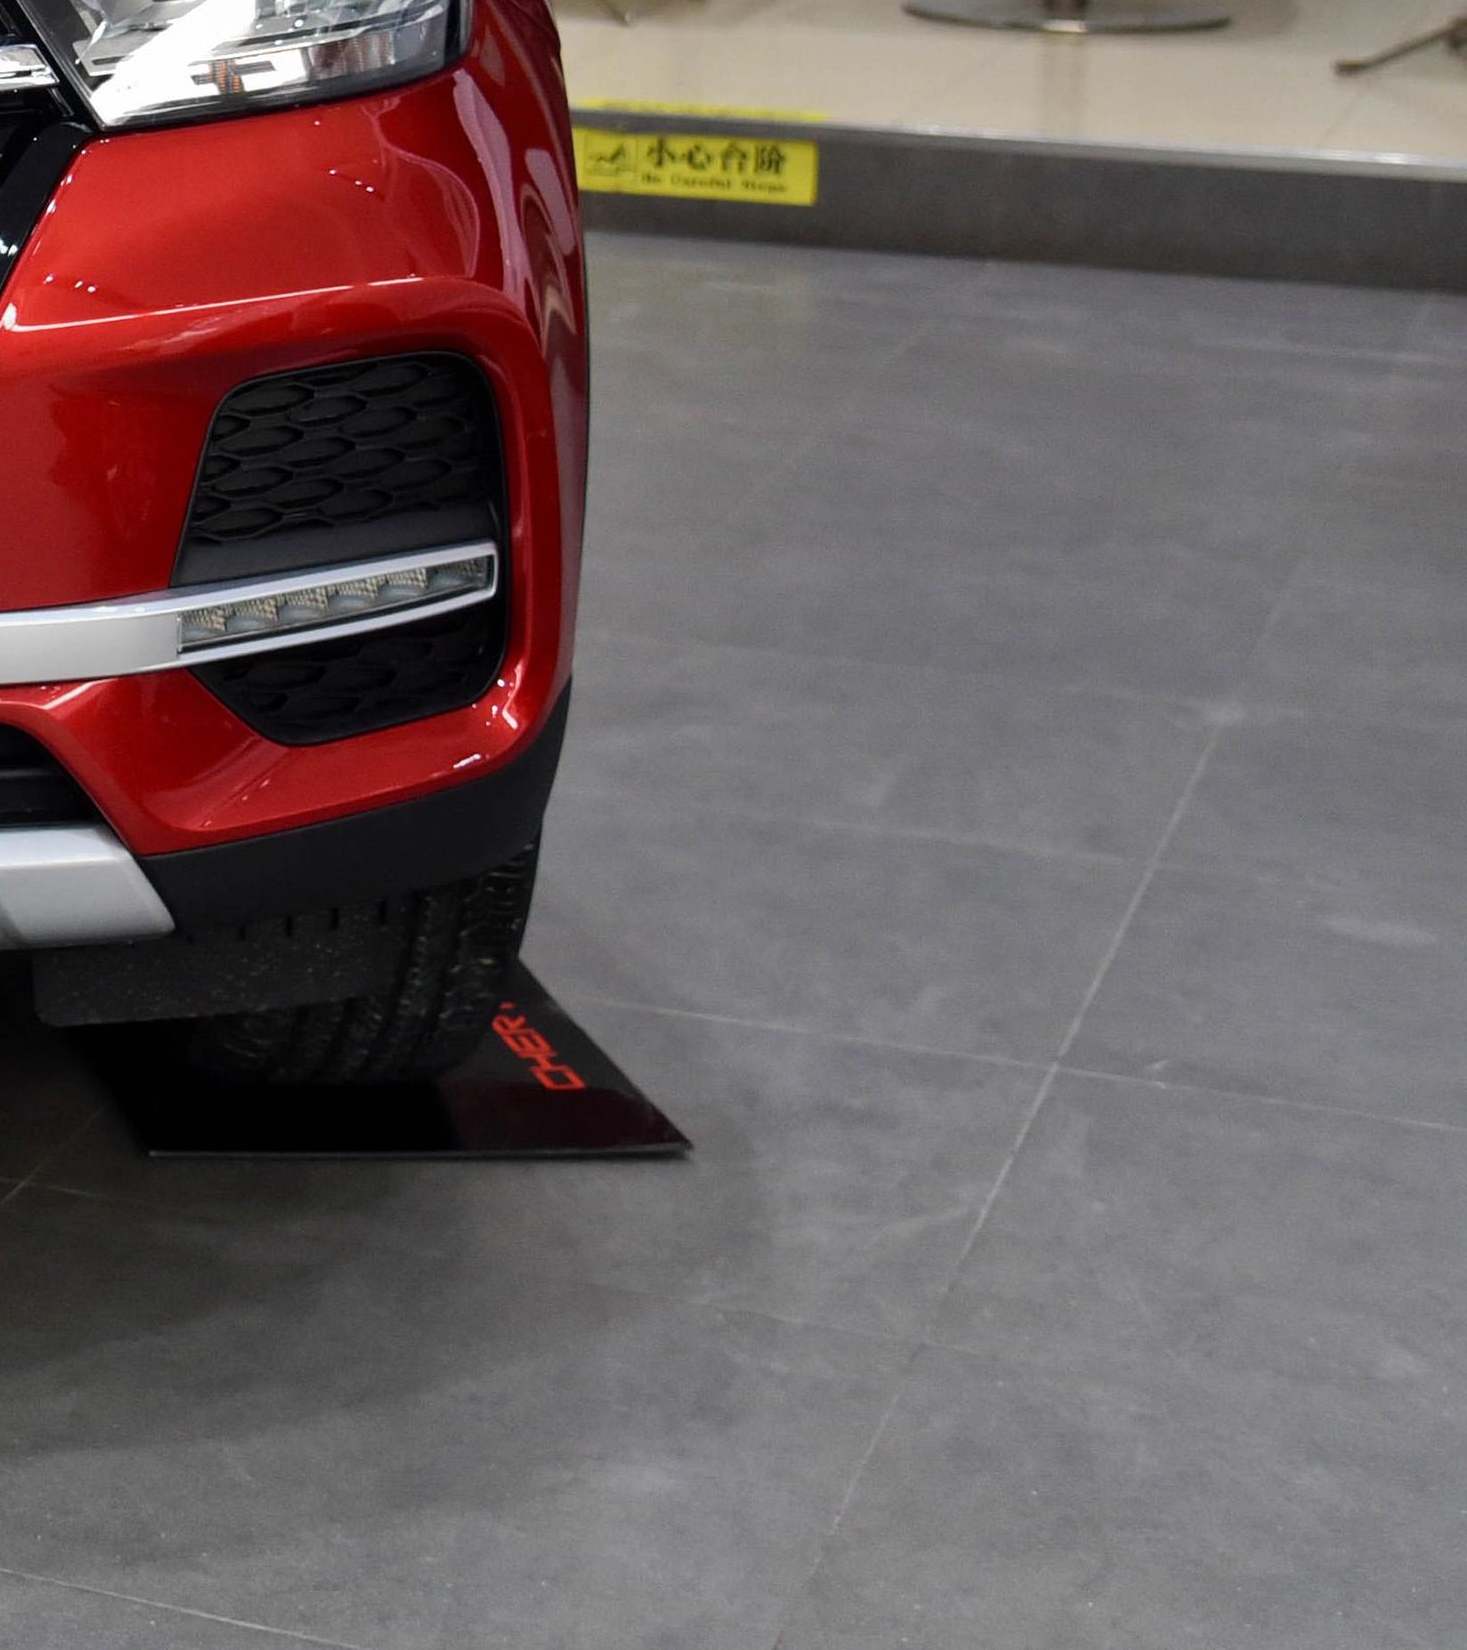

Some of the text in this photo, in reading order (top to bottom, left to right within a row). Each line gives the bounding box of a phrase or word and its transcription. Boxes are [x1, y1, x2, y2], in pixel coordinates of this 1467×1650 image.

[647, 138, 787, 175] 小心台阶
[491, 1001, 586, 1090] CHER
